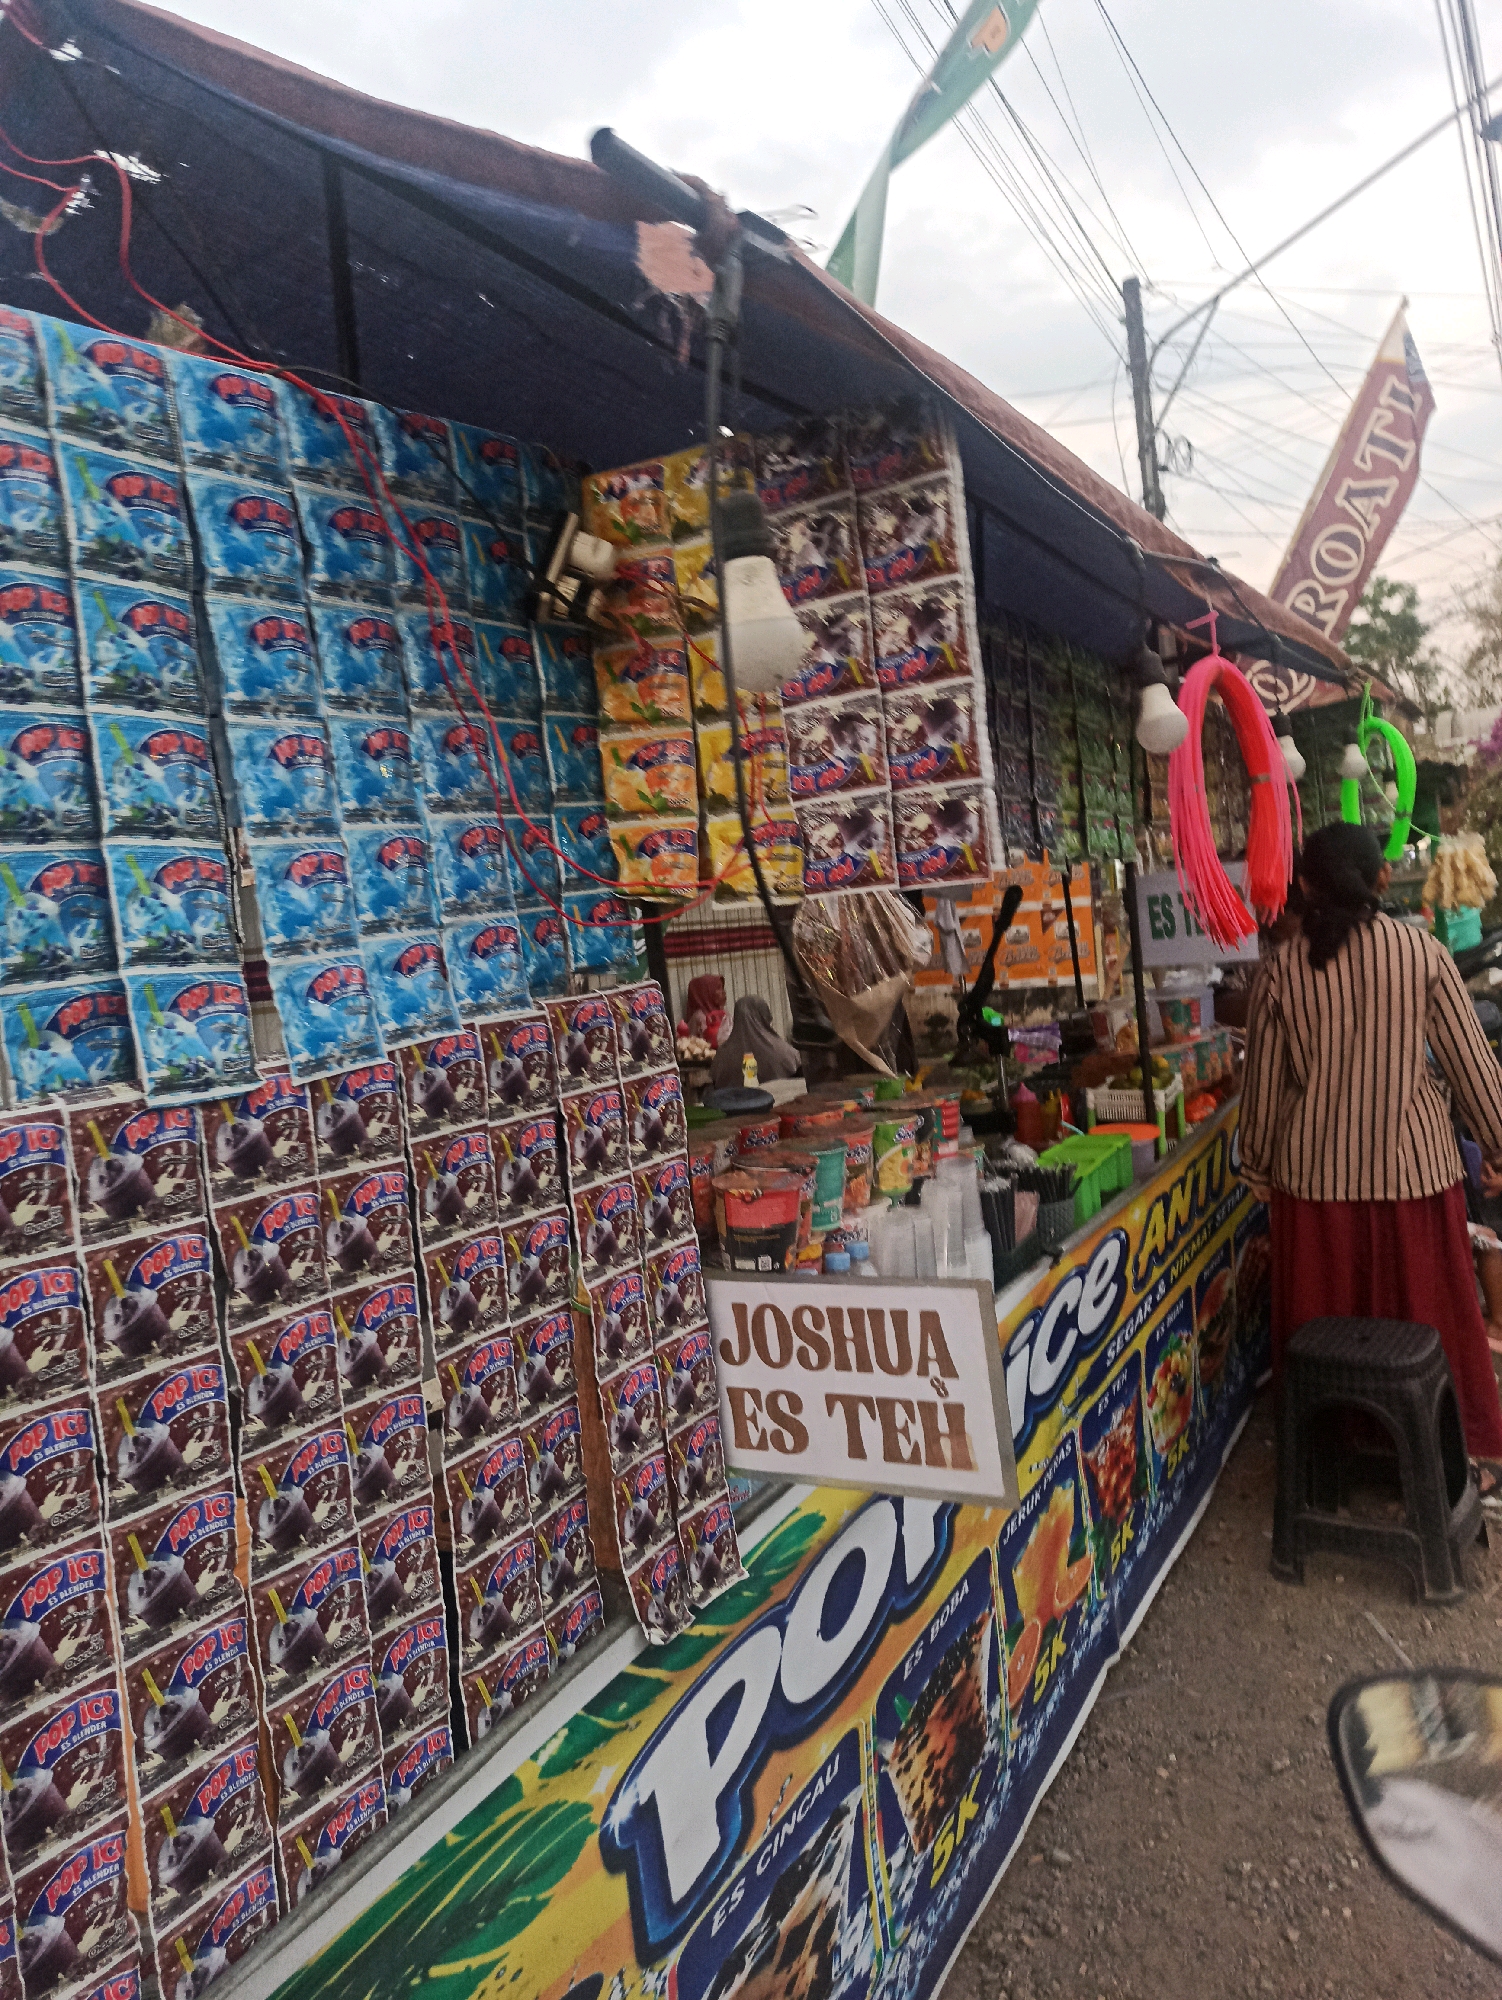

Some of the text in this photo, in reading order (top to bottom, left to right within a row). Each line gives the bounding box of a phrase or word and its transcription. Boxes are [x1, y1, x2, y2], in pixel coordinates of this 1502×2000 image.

[1147, 893, 1176, 941] ES
[0, 1130, 22, 1163] OP
[719, 1302, 959, 1380] JOSHUA
[929, 1375, 949, 1398] &
[725, 1387, 978, 1472] ES TEH
[1003, 1487, 1042, 1545] JERUK
[903, 1578, 970, 1682] ES BOBA
[1033, 1612, 1067, 1705] 5K
[711, 1752, 840, 1938] ES CINCAU
[930, 1768, 982, 1889] 5K
